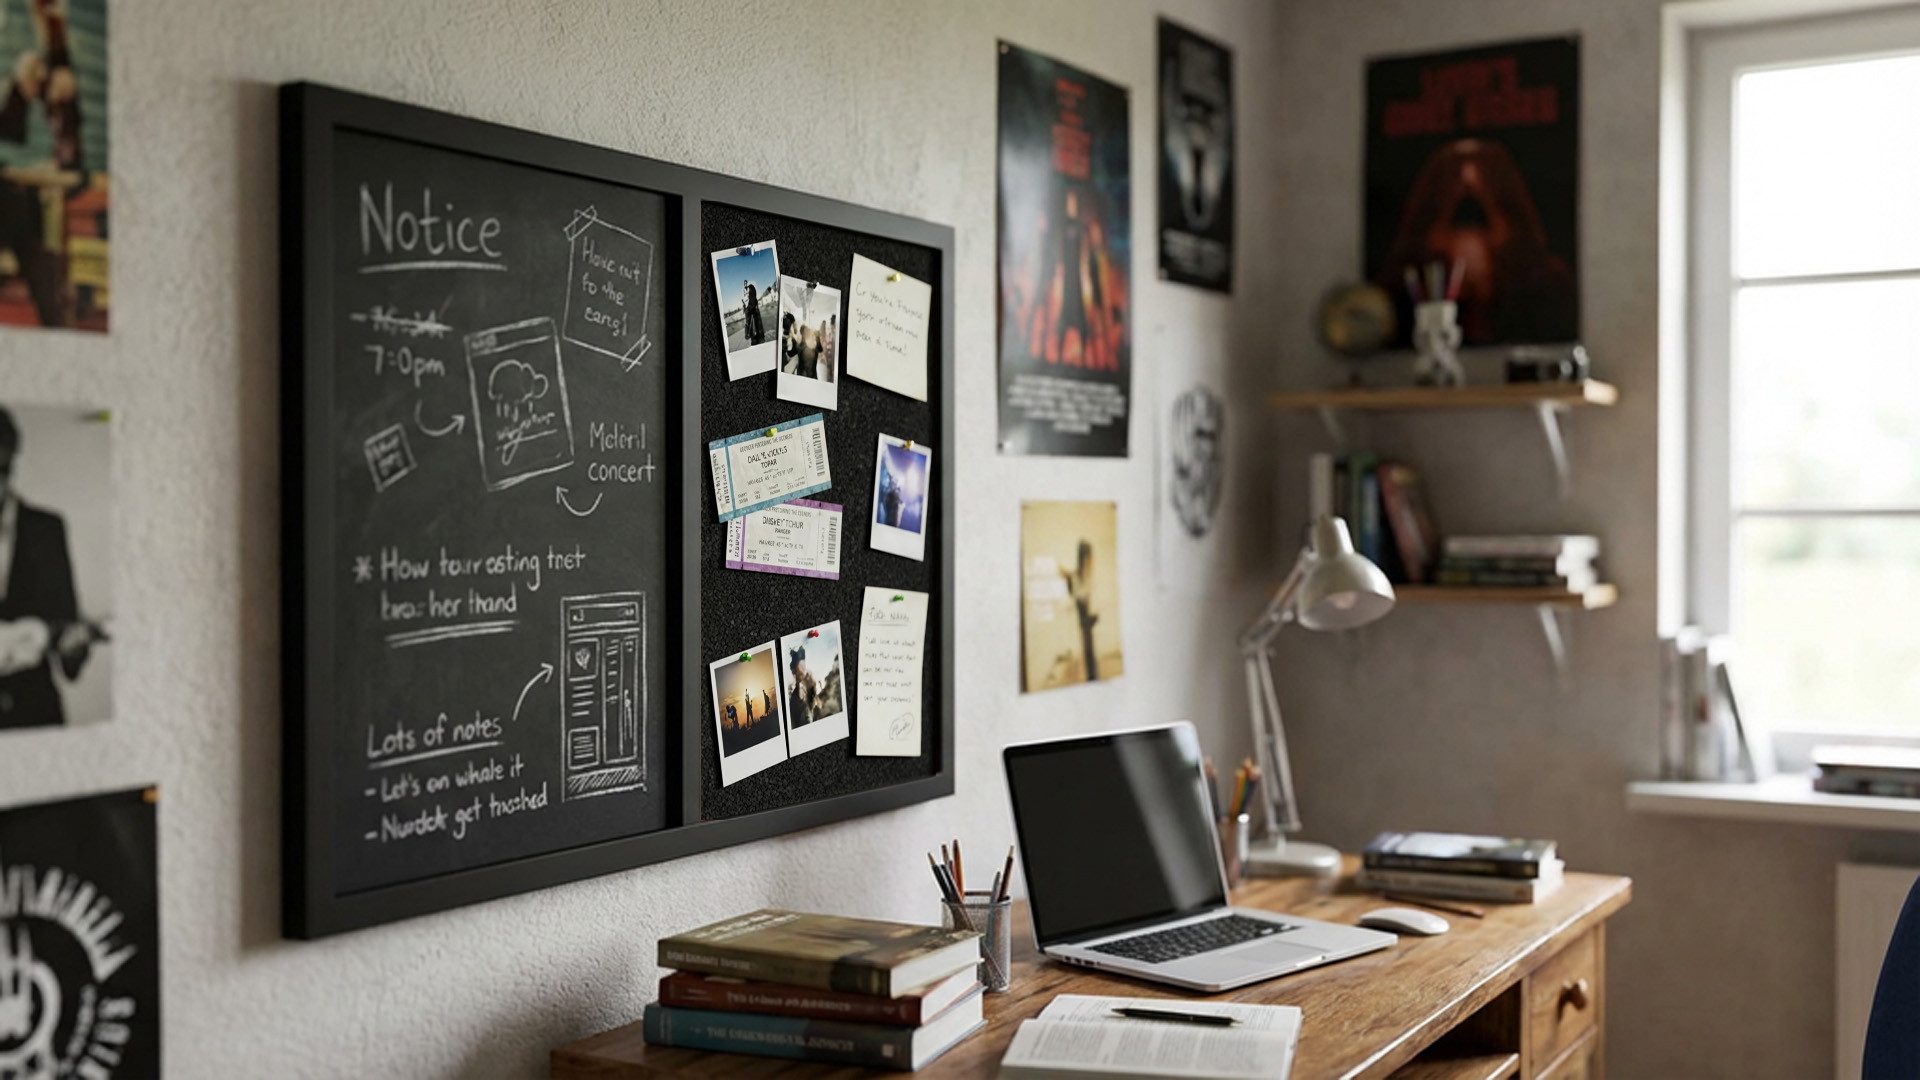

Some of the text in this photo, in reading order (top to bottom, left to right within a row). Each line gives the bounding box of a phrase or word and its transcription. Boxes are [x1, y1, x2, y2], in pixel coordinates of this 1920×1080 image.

[360, 181, 502, 257] Notice
[588, 453, 656, 483] concert
[381, 546, 430, 583] How
[367, 710, 503, 759] Lots of notes
[510, 752, 524, 778] it
[453, 797, 482, 841] get
